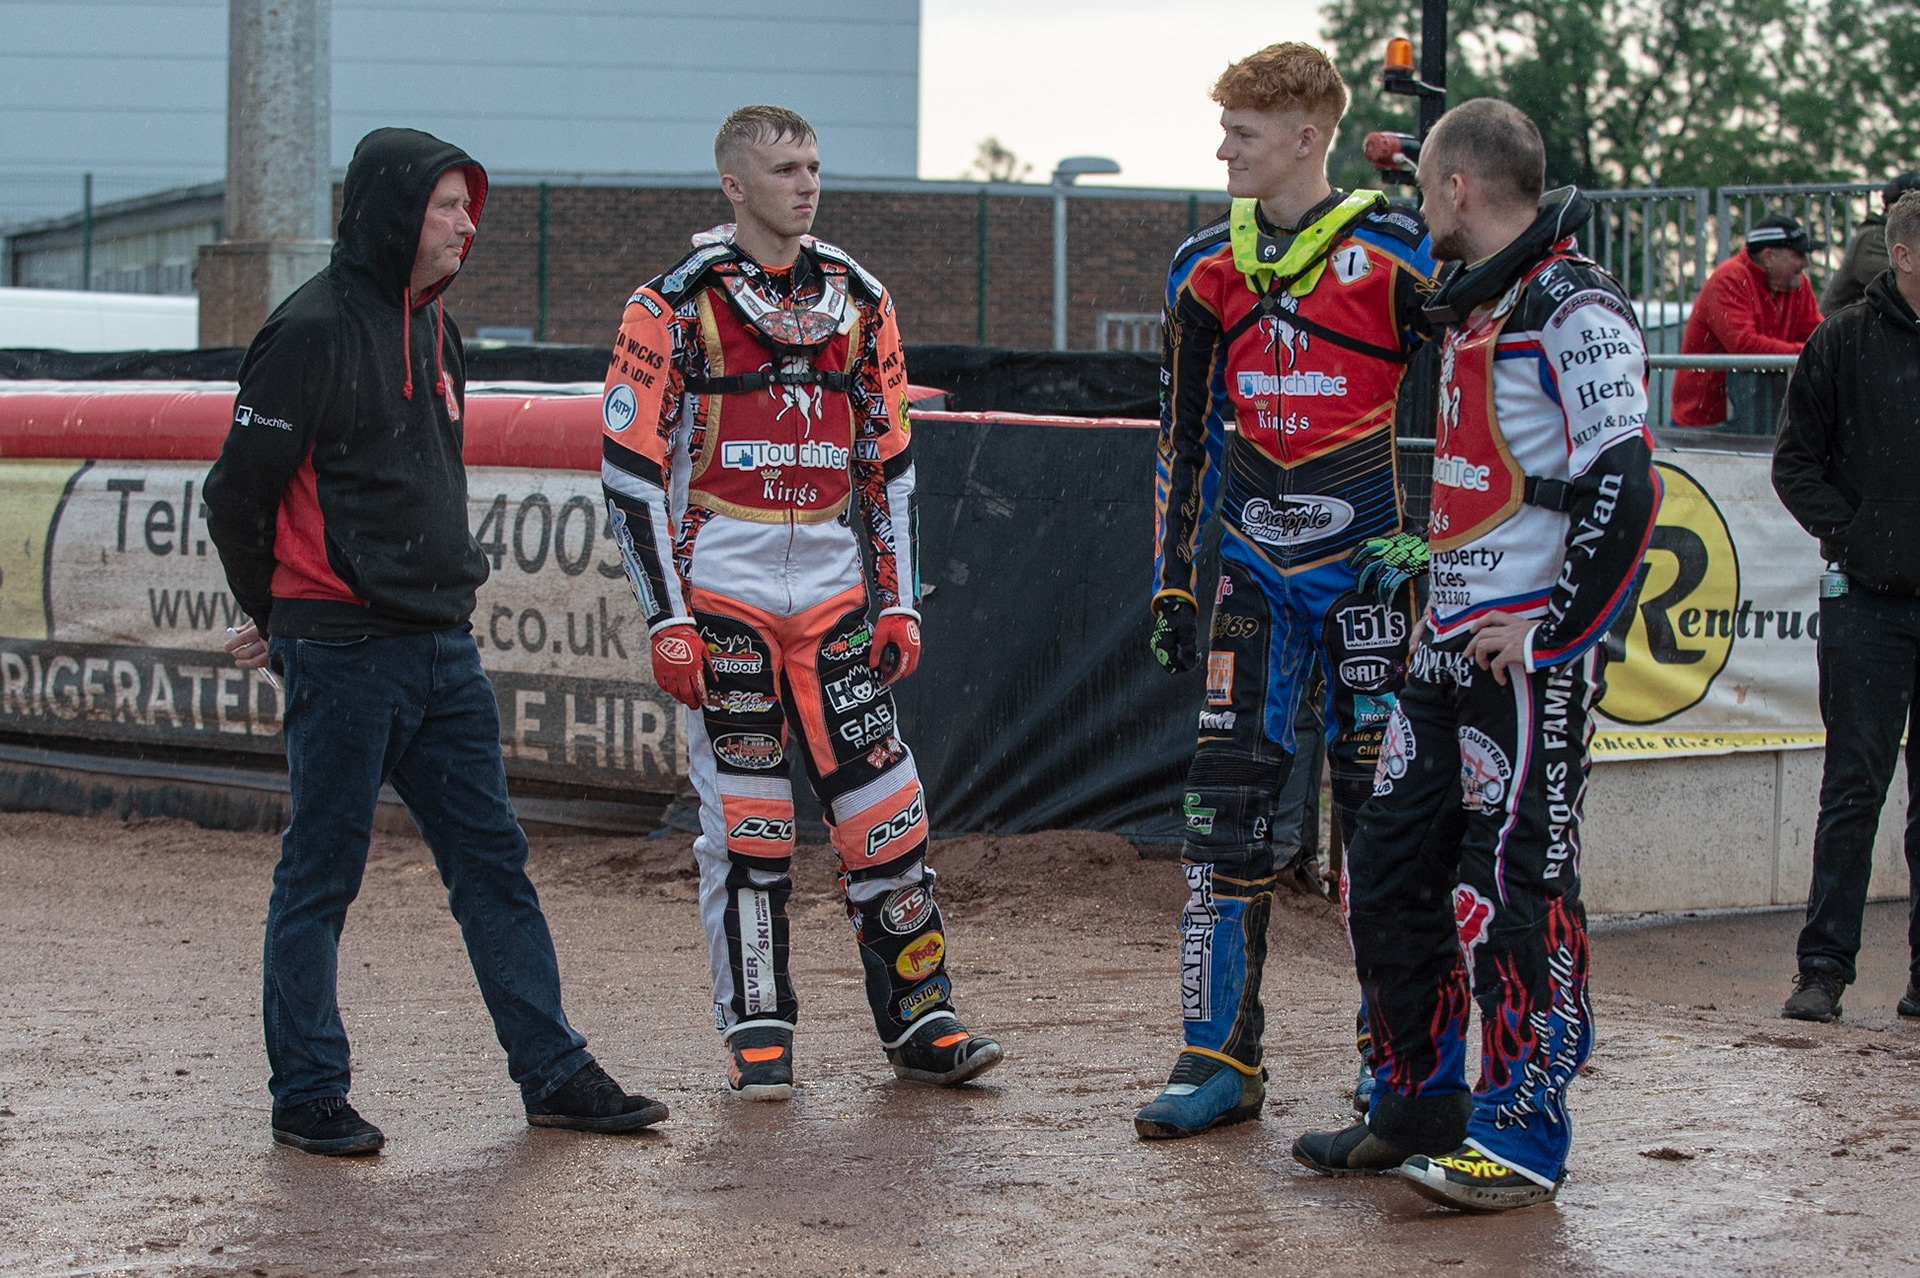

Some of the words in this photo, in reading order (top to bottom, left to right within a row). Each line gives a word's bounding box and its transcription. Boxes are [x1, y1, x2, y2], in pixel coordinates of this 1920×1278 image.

[1558, 339, 1632, 373] Poppa
[1252, 372, 1346, 394] TouchTec
[1575, 373, 1635, 411] Herb
[253, 413, 293, 431] TouchTec
[1257, 410, 1310, 435] Kings
[753, 441, 848, 467] TouchTec
[763, 479, 818, 507] Kings
[1244, 499, 1333, 536] Chapple
[1570, 472, 1624, 560] Nan
[840, 702, 892, 742] GAB
[853, 720, 894, 750] RACING
[1592, 736, 1658, 751] ehicle
[1542, 760, 1573, 880] BROOKS
[890, 887, 926, 923] STS
[756, 922, 771, 951] SKI
[746, 956, 761, 1013] SILVER
[900, 981, 941, 1011] CUSTOM
